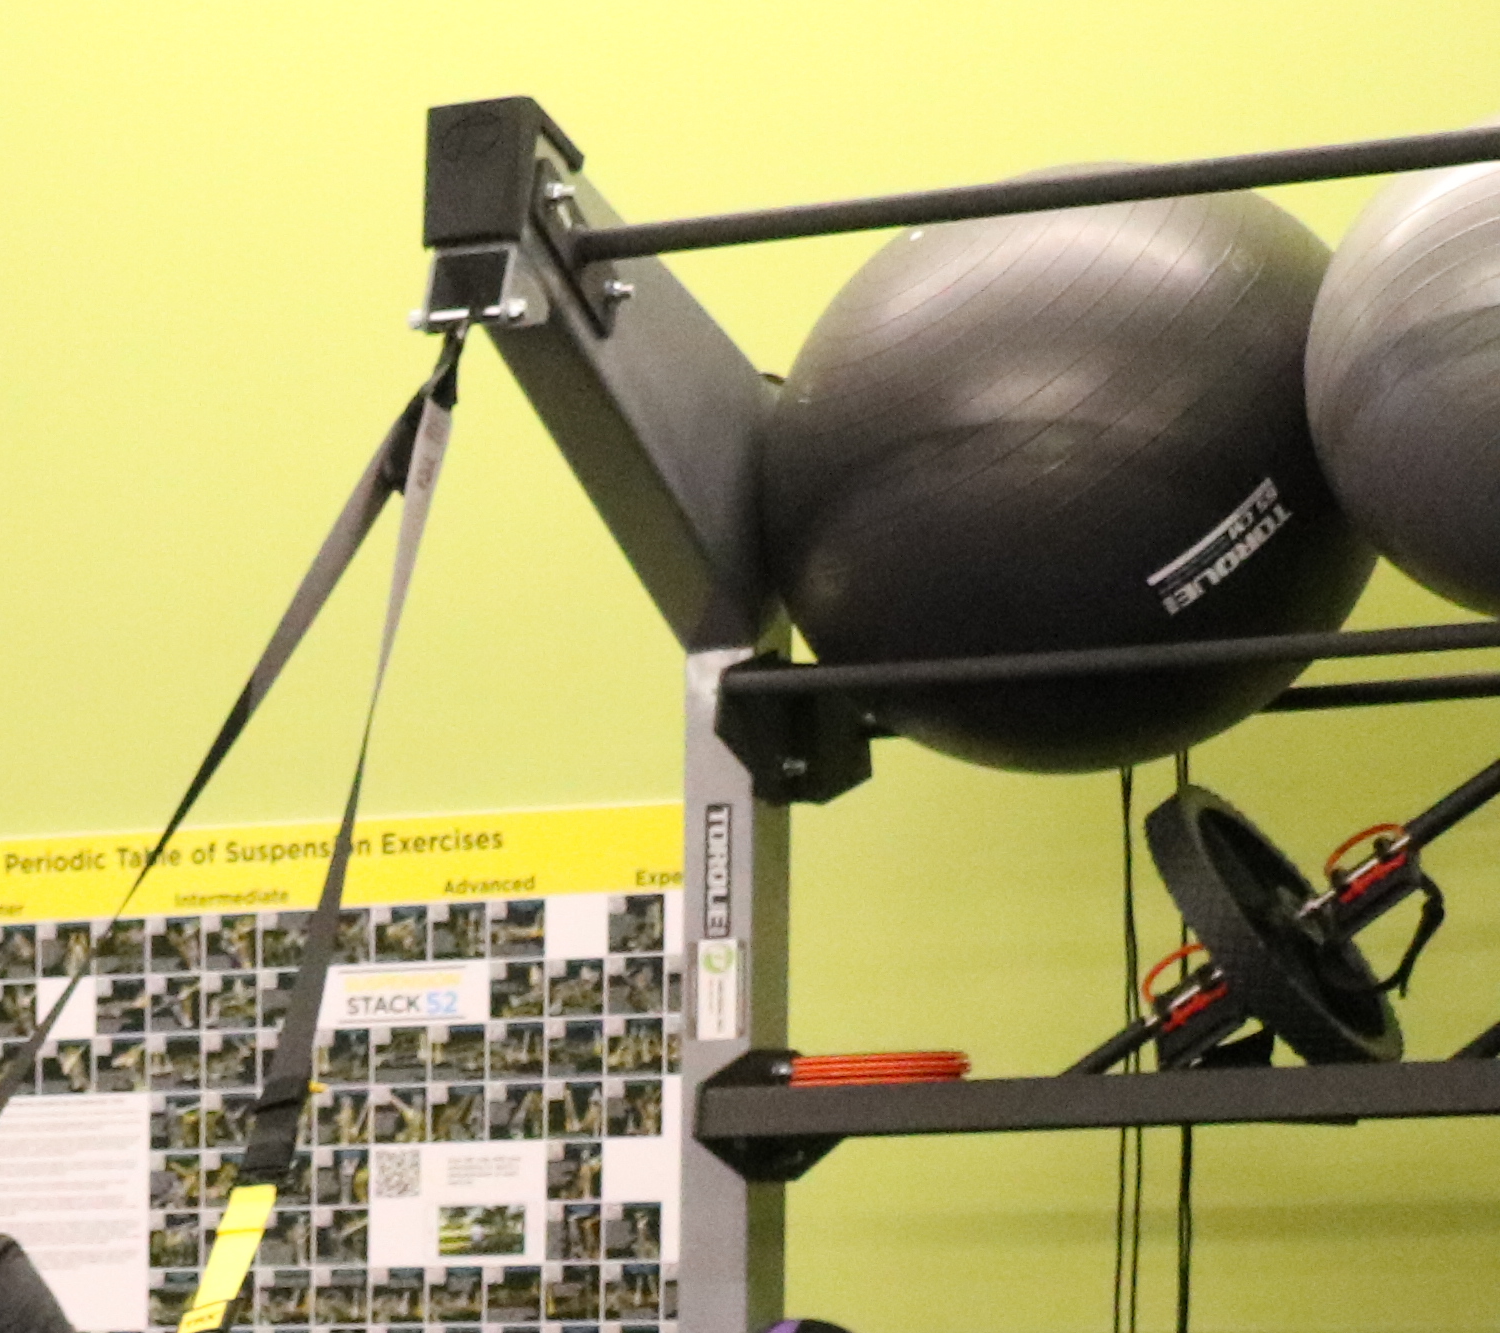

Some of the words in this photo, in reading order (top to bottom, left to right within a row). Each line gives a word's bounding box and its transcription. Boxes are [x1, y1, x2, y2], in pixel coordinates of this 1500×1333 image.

[4, 849, 107, 875] Periodic
[191, 842, 216, 866] of
[225, 838, 371, 865] Suspensn
[381, 829, 504, 856] Exercises
[444, 876, 536, 896] Advanced
[635, 868, 683, 888] Expe
[173, 888, 290, 908] Intermediate
[347, 995, 420, 1015] STACK
[426, 990, 458, 1014] 52
